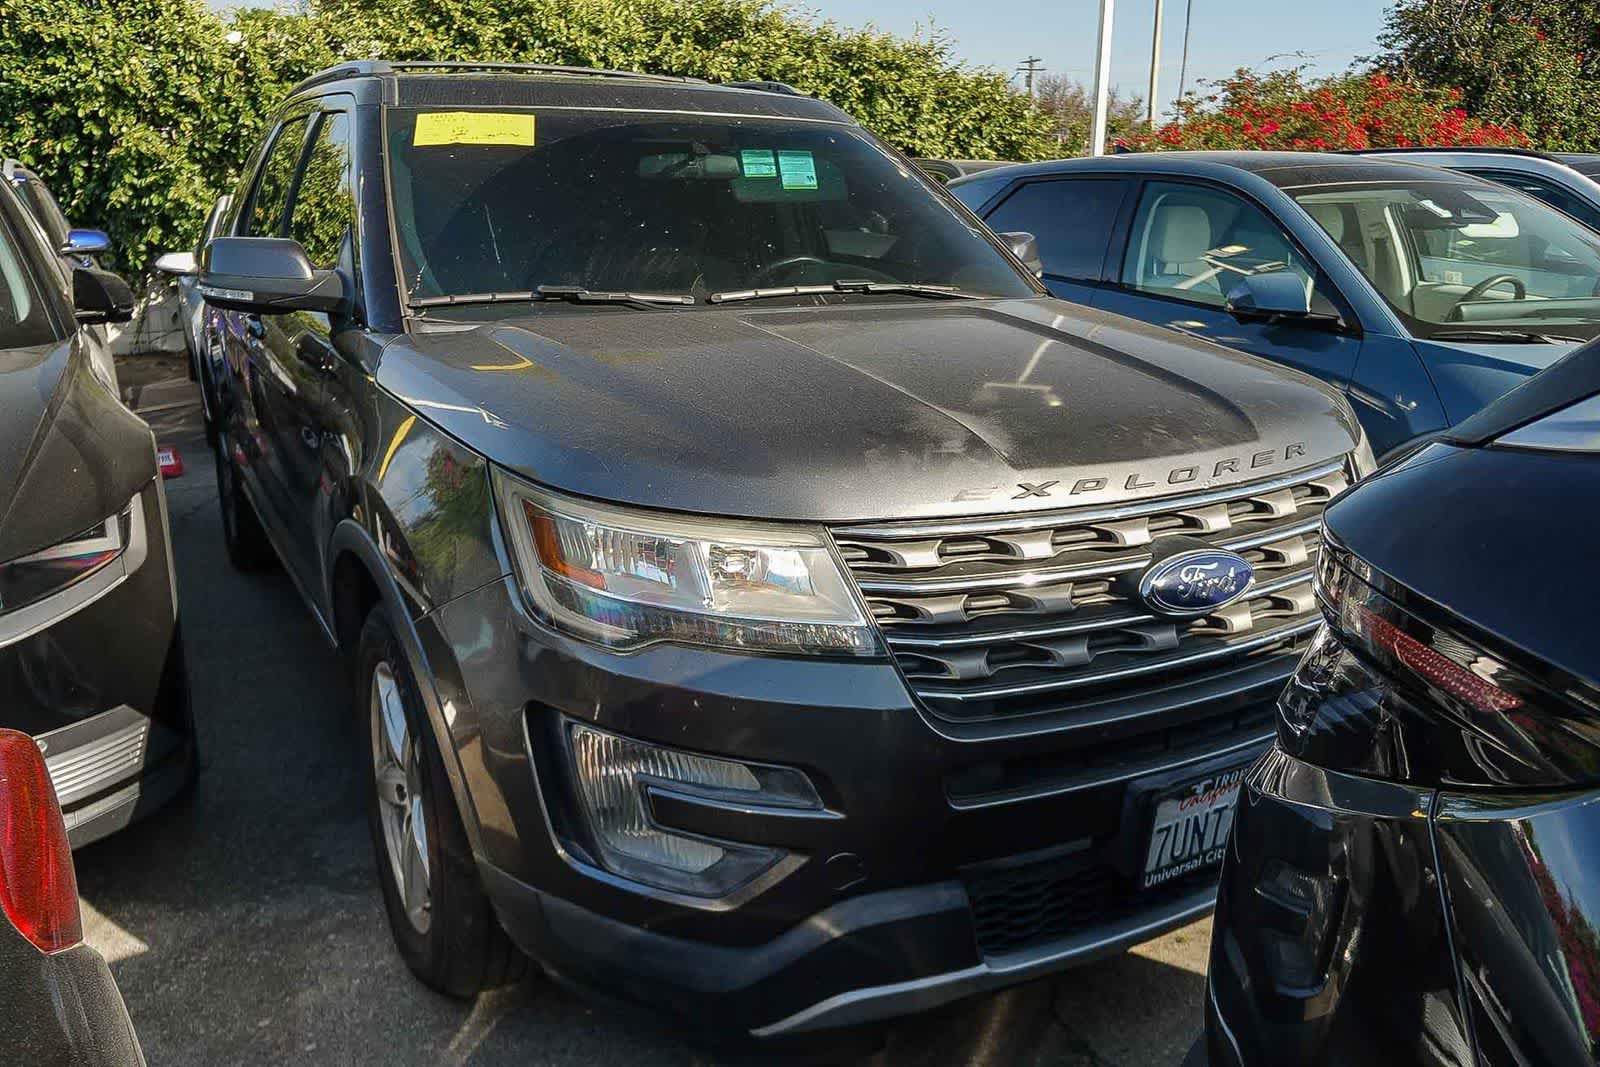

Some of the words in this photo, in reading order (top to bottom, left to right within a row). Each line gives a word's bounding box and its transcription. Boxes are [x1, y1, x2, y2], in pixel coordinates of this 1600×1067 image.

[951, 441, 1306, 502] EXPLORER
[1177, 562, 1236, 599] Ford
[1153, 803, 1230, 870] 7UNT
[1144, 854, 1203, 888] Universal
